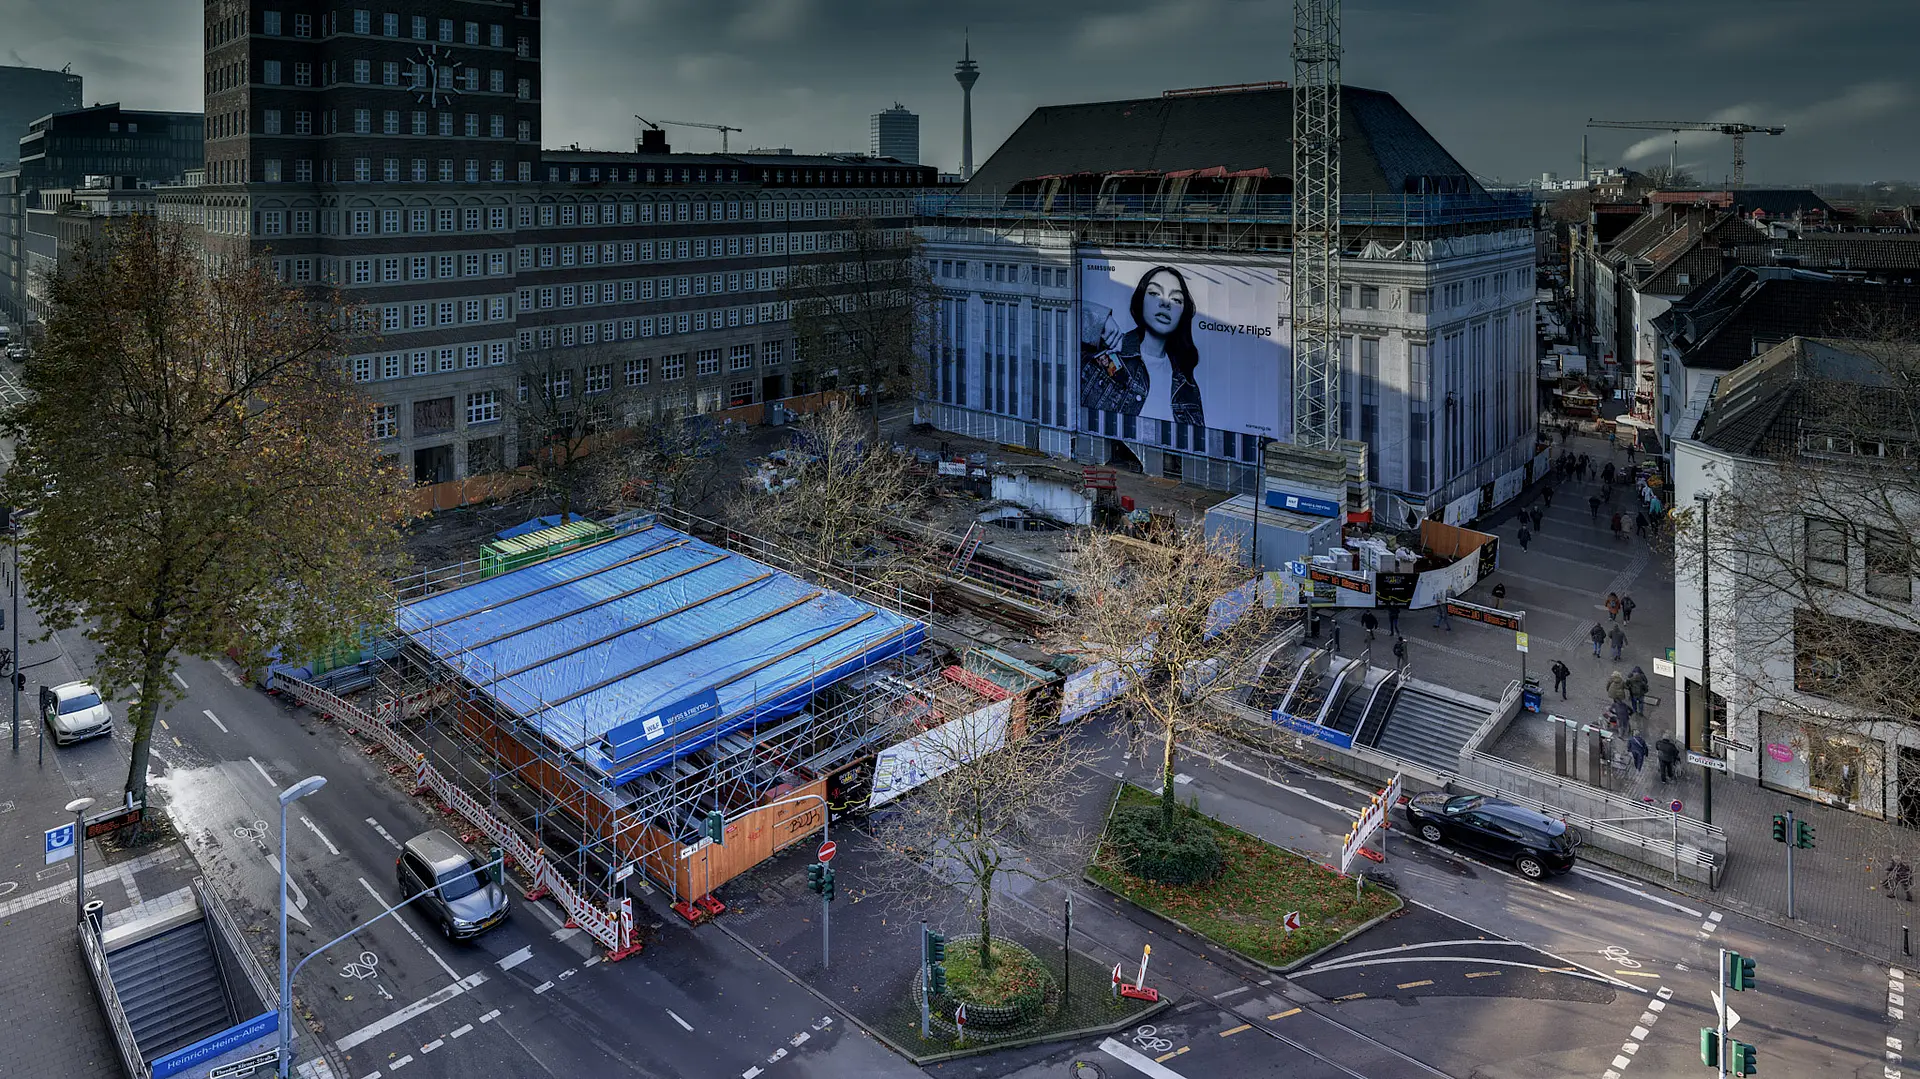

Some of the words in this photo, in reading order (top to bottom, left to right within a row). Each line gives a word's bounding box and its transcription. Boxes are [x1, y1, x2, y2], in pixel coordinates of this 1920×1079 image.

[1086, 264, 1116, 272] SAMSUNG
[1198, 320, 1237, 335] Galaxy
[1238, 324, 1245, 334] Z
[1246, 325, 1272, 338] Flip5
[1293, 563, 1305, 575] U
[646, 722, 660, 732] W&F
[1689, 755, 1716, 767] Polizei
[50, 828, 70, 848] U
[167, 1022, 266, 1070] Heinrich-Heine-Allee
